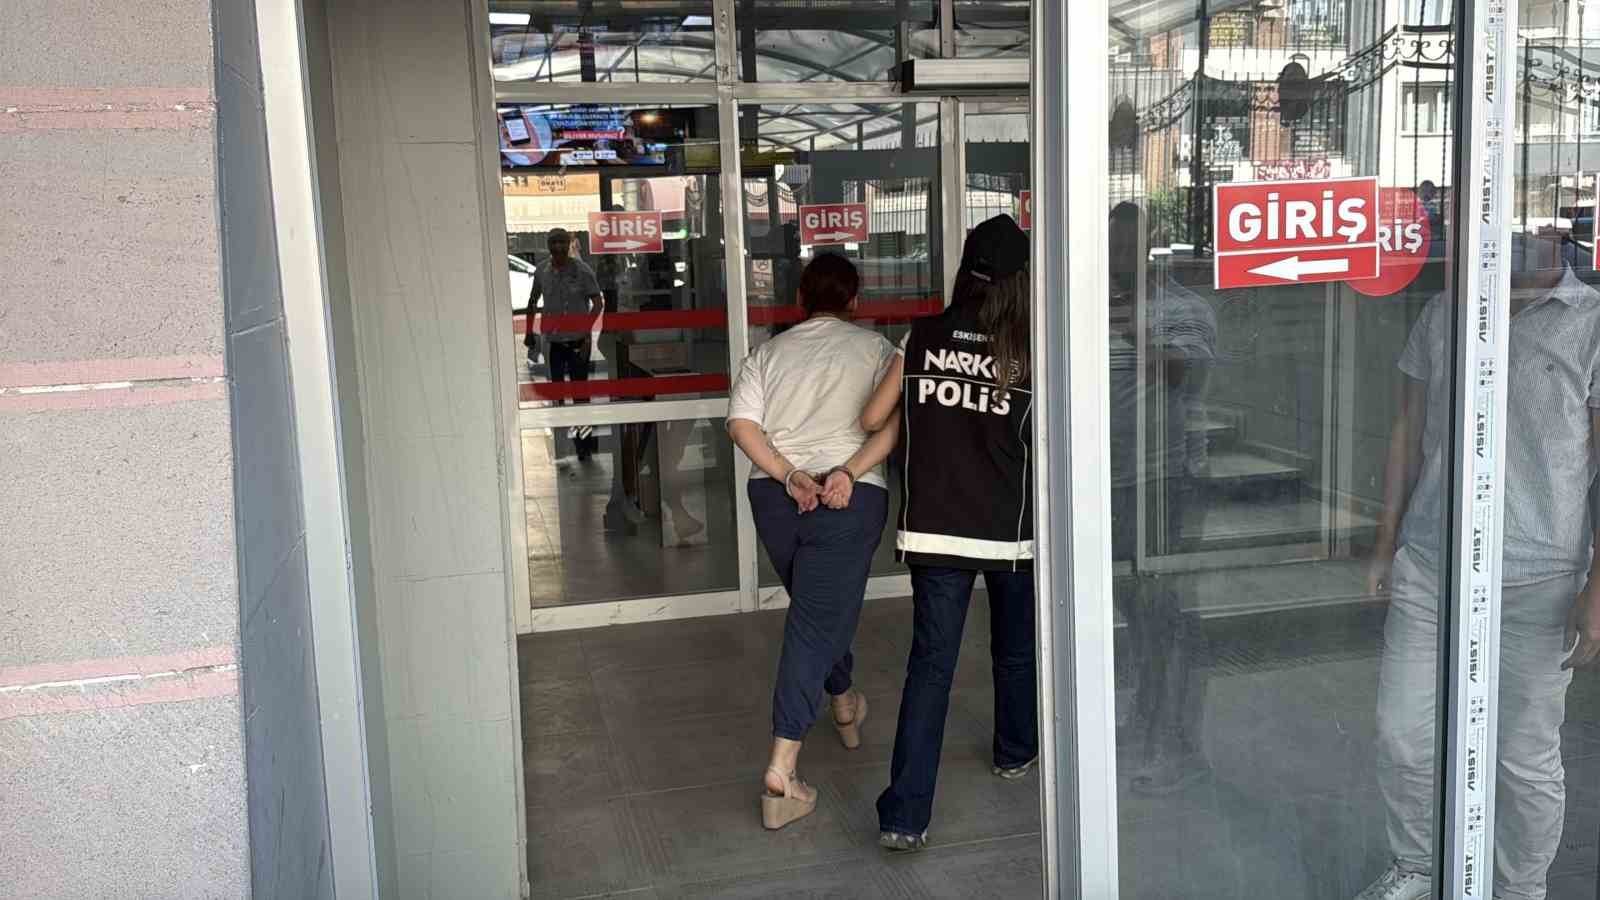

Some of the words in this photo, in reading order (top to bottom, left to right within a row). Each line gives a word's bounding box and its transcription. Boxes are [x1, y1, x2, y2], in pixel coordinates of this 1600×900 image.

[594, 217, 657, 237] GİRİŞ
[805, 208, 864, 230] GİRİŞ
[1228, 190, 1368, 243] GİRİŞ
[1379, 218, 1423, 254] RİŞ
